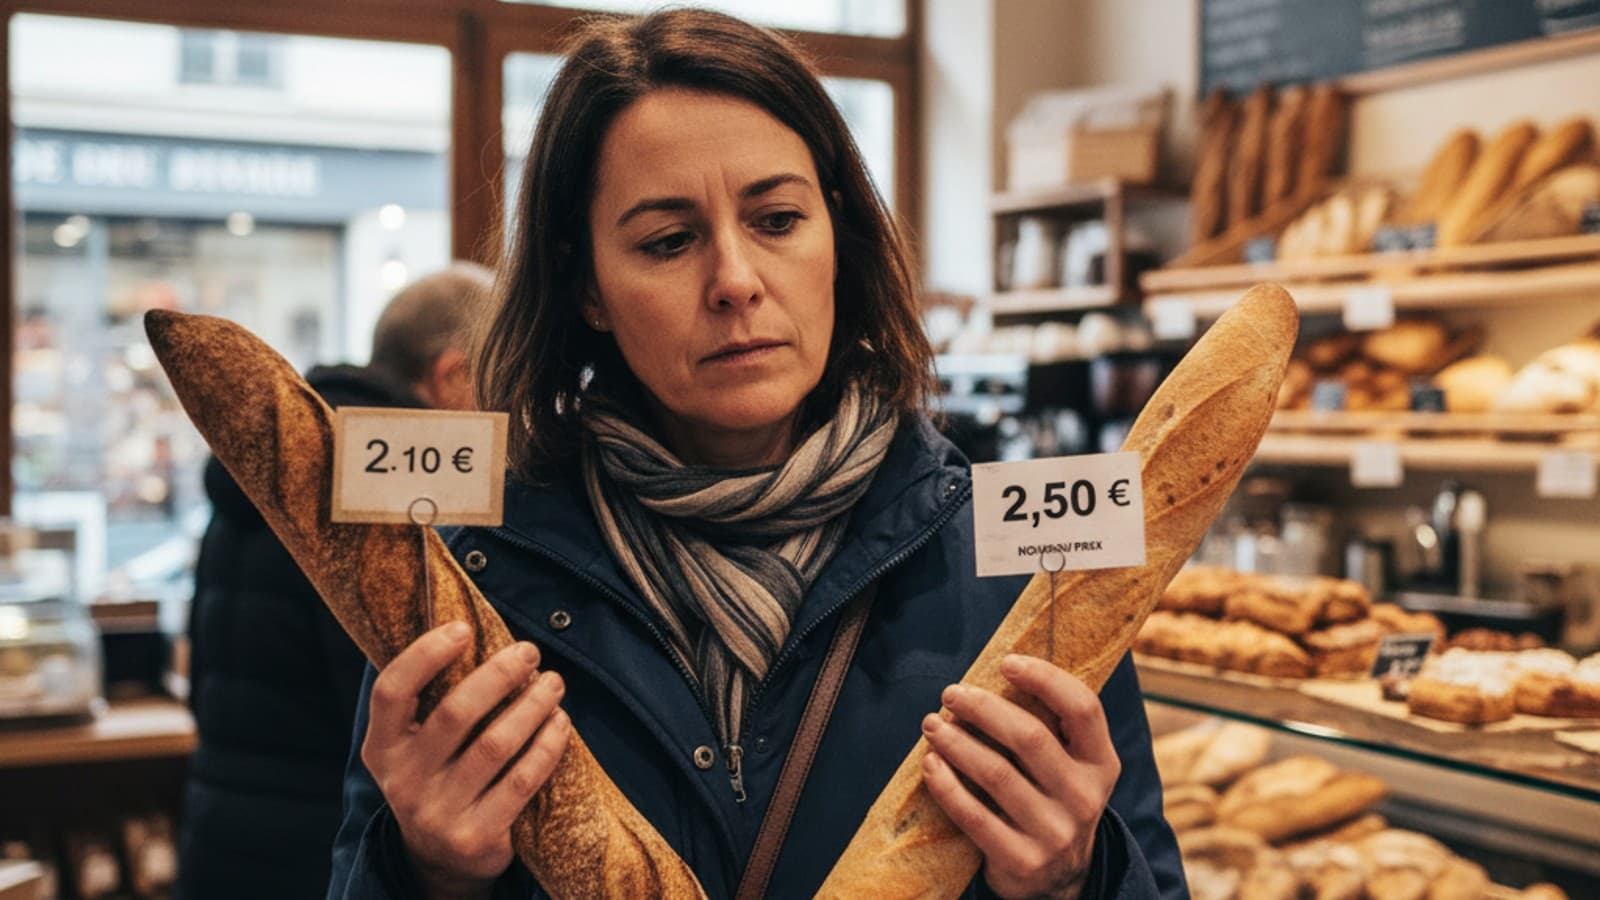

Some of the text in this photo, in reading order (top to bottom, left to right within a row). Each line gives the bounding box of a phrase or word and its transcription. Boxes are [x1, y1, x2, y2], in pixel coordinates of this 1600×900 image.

[365, 439, 474, 474] 2.10 €
[1001, 479, 1131, 529] 2,50 €
